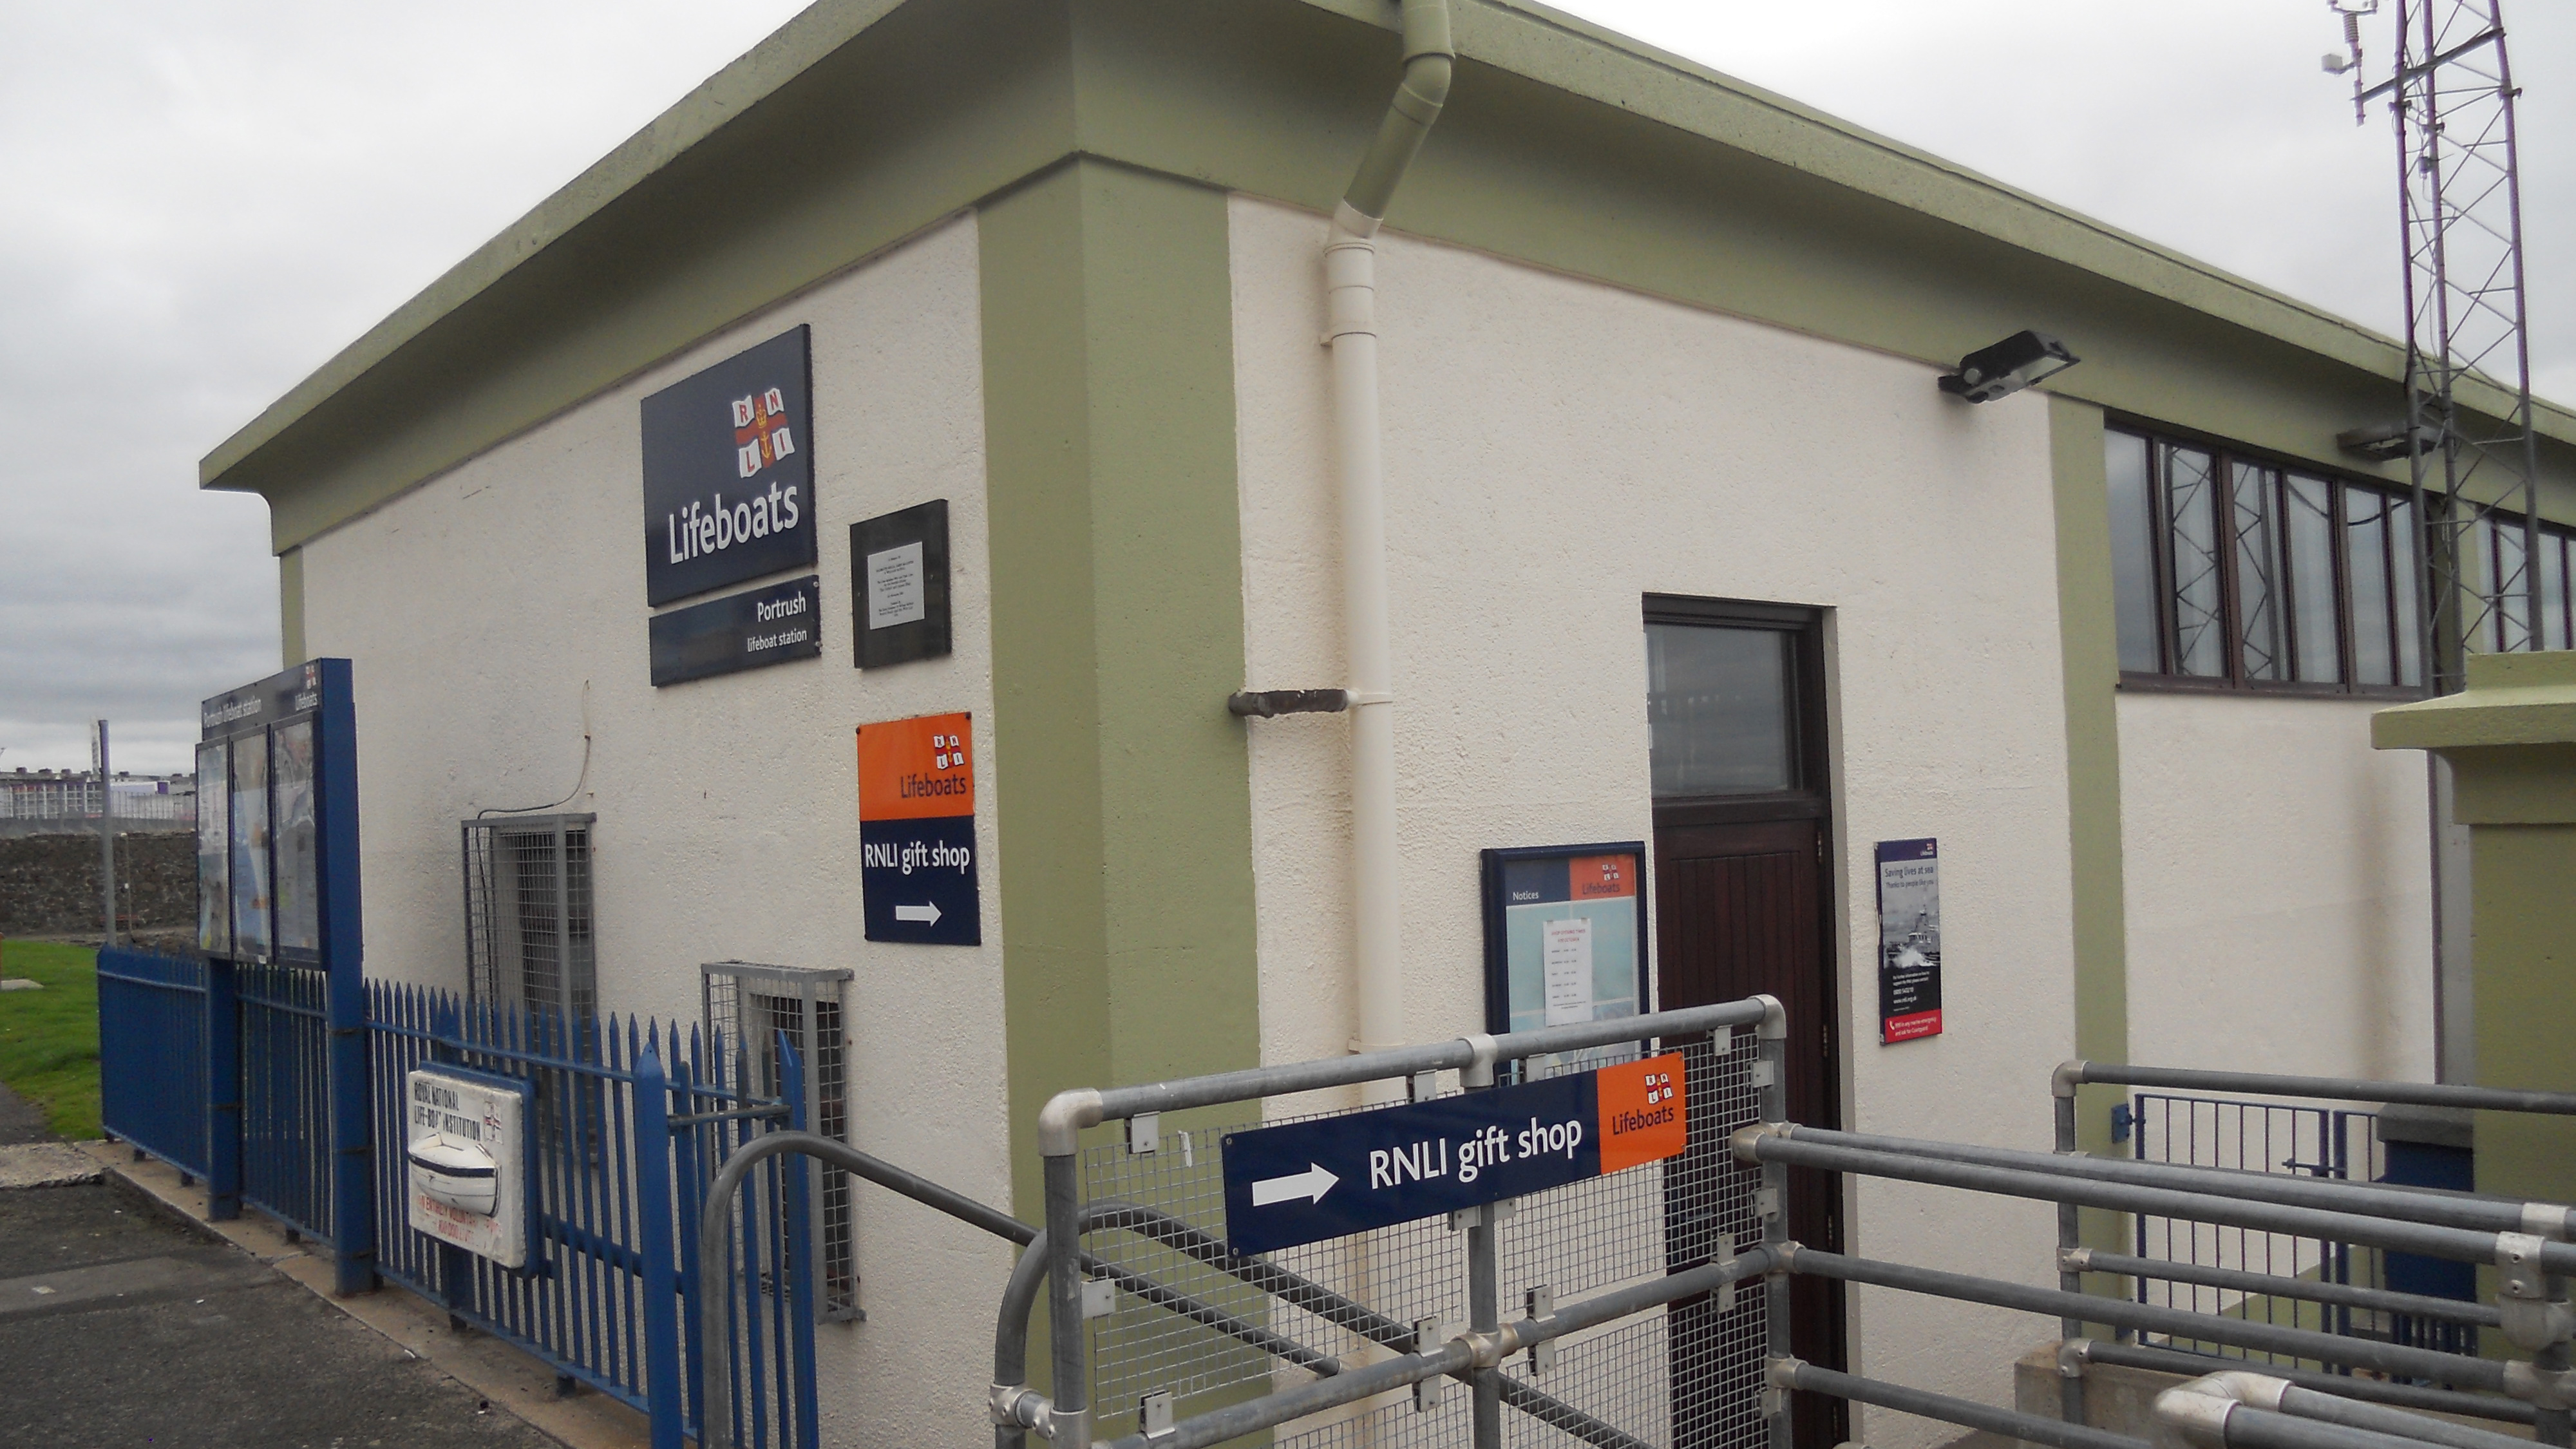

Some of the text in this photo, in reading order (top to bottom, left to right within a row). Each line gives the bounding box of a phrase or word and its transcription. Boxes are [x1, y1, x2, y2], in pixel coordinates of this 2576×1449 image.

[669, 482, 799, 564] Lifeboats
[757, 591, 806, 622] Portrush
[748, 628, 807, 652] lifeboat station
[900, 773, 966, 799] Lifeboats
[865, 840, 970, 875] RNLI gift shop
[1885, 867, 1903, 879] Saving
[1513, 891, 1539, 901] Notices
[1582, 882, 1620, 895] Lifeboats
[1612, 1106, 1674, 1135] Lifeboats
[1370, 1117, 1582, 1190] RNLI gift shop
